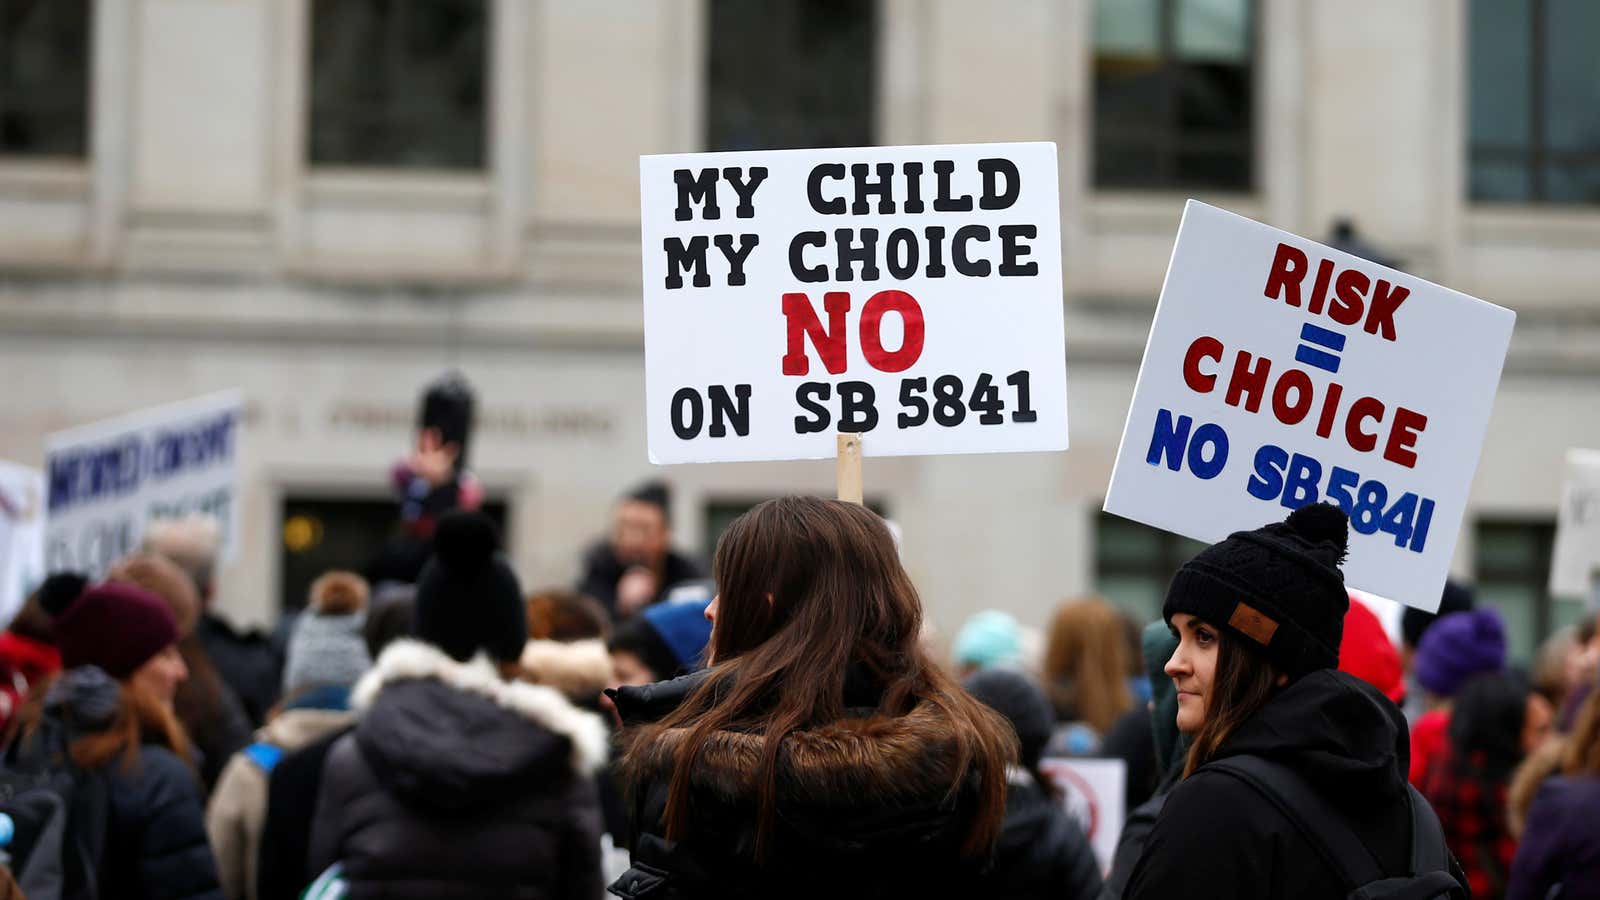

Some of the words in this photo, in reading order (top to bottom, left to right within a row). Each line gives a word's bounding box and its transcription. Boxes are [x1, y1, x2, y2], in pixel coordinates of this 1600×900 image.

[673, 166, 769, 222] MY
[806, 157, 1021, 216] CHILD
[663, 233, 760, 290] MY
[788, 224, 1039, 284] CHOICE
[1264, 242, 1410, 342] RISK
[781, 289, 925, 377] NO
[670, 383, 752, 441] ON
[794, 380, 879, 434] SB
[897, 369, 1038, 430] 5841
[1182, 336, 1428, 469] CHOICE
[1145, 408, 1230, 480] NO
